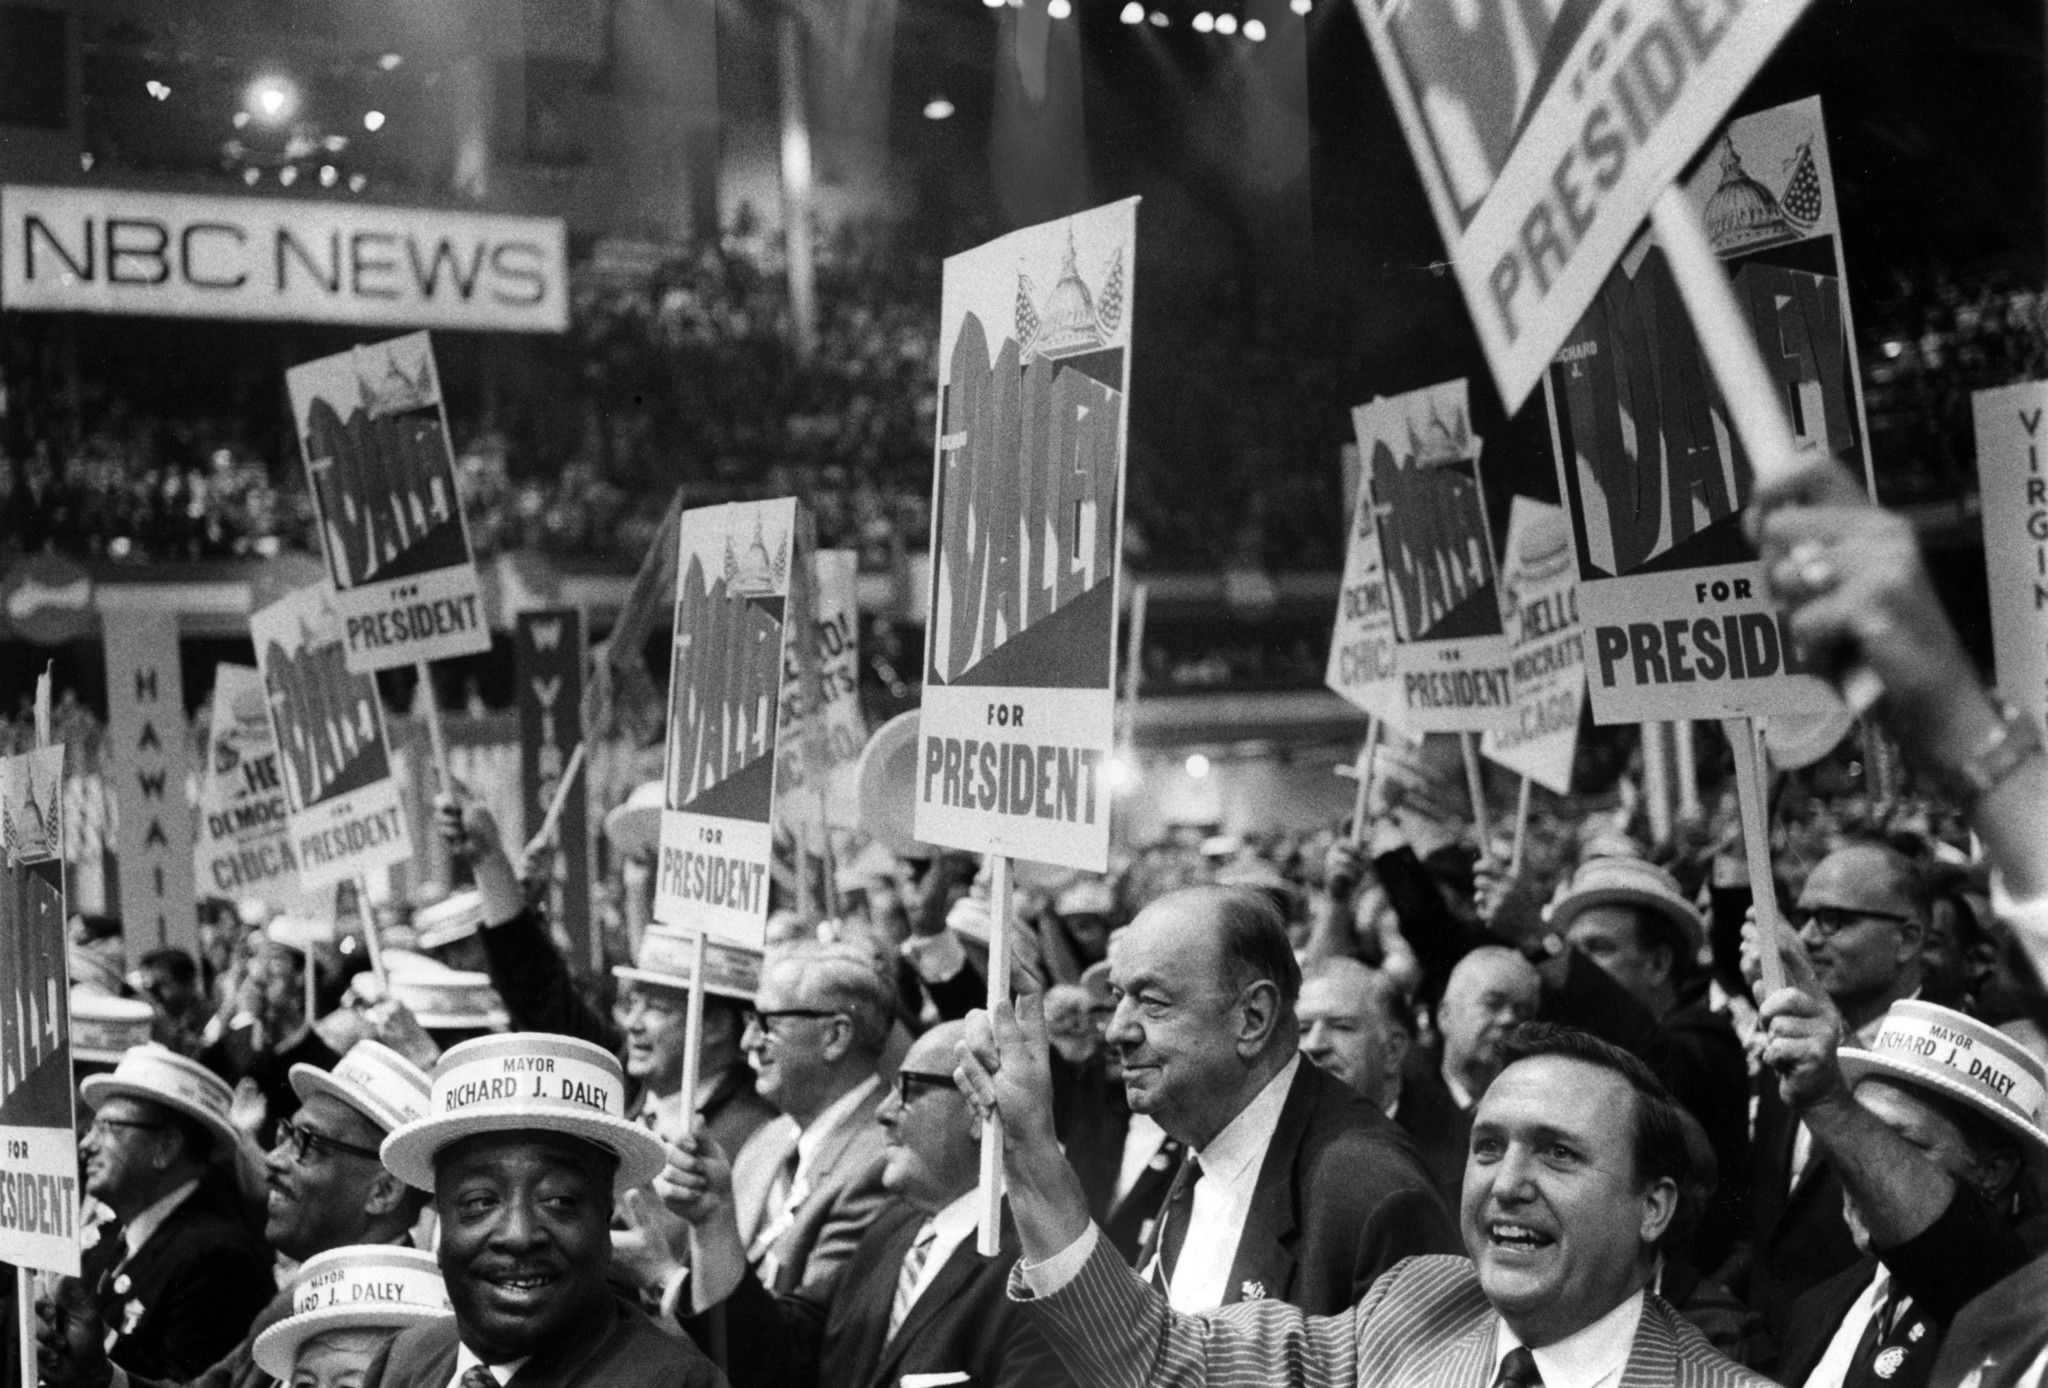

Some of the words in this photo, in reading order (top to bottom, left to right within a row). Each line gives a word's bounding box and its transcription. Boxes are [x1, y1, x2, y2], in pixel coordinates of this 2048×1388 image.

[23, 214, 248, 290] NBC
[274, 225, 547, 304] NEWS
[1695, 578, 1753, 604] FOR
[346, 595, 479, 652] PRESIDENT
[1404, 668, 1511, 711] PRESIDENT
[987, 703, 1025, 728] FOR
[923, 735, 1106, 825] PRESIDENT
[300, 804, 402, 869] PRESIDENT
[699, 827, 723, 845] FOR
[660, 850, 766, 916] PRESIDENT
[1930, 1024, 1974, 1051] MAYOR
[502, 1057, 556, 1074] MAYOR
[1945, 1049, 1957, 1069] J.
[1968, 1058, 2016, 1098] DALEY
[445, 1076, 518, 1113] RICHARD
[531, 1076, 547, 1099] J.
[561, 1078, 610, 1112] DALEY
[8, 1139, 30, 1160] FOR
[310, 1269, 346, 1290] MAYOR
[328, 1287, 340, 1306] J.
[351, 1282, 405, 1302] DALEY
